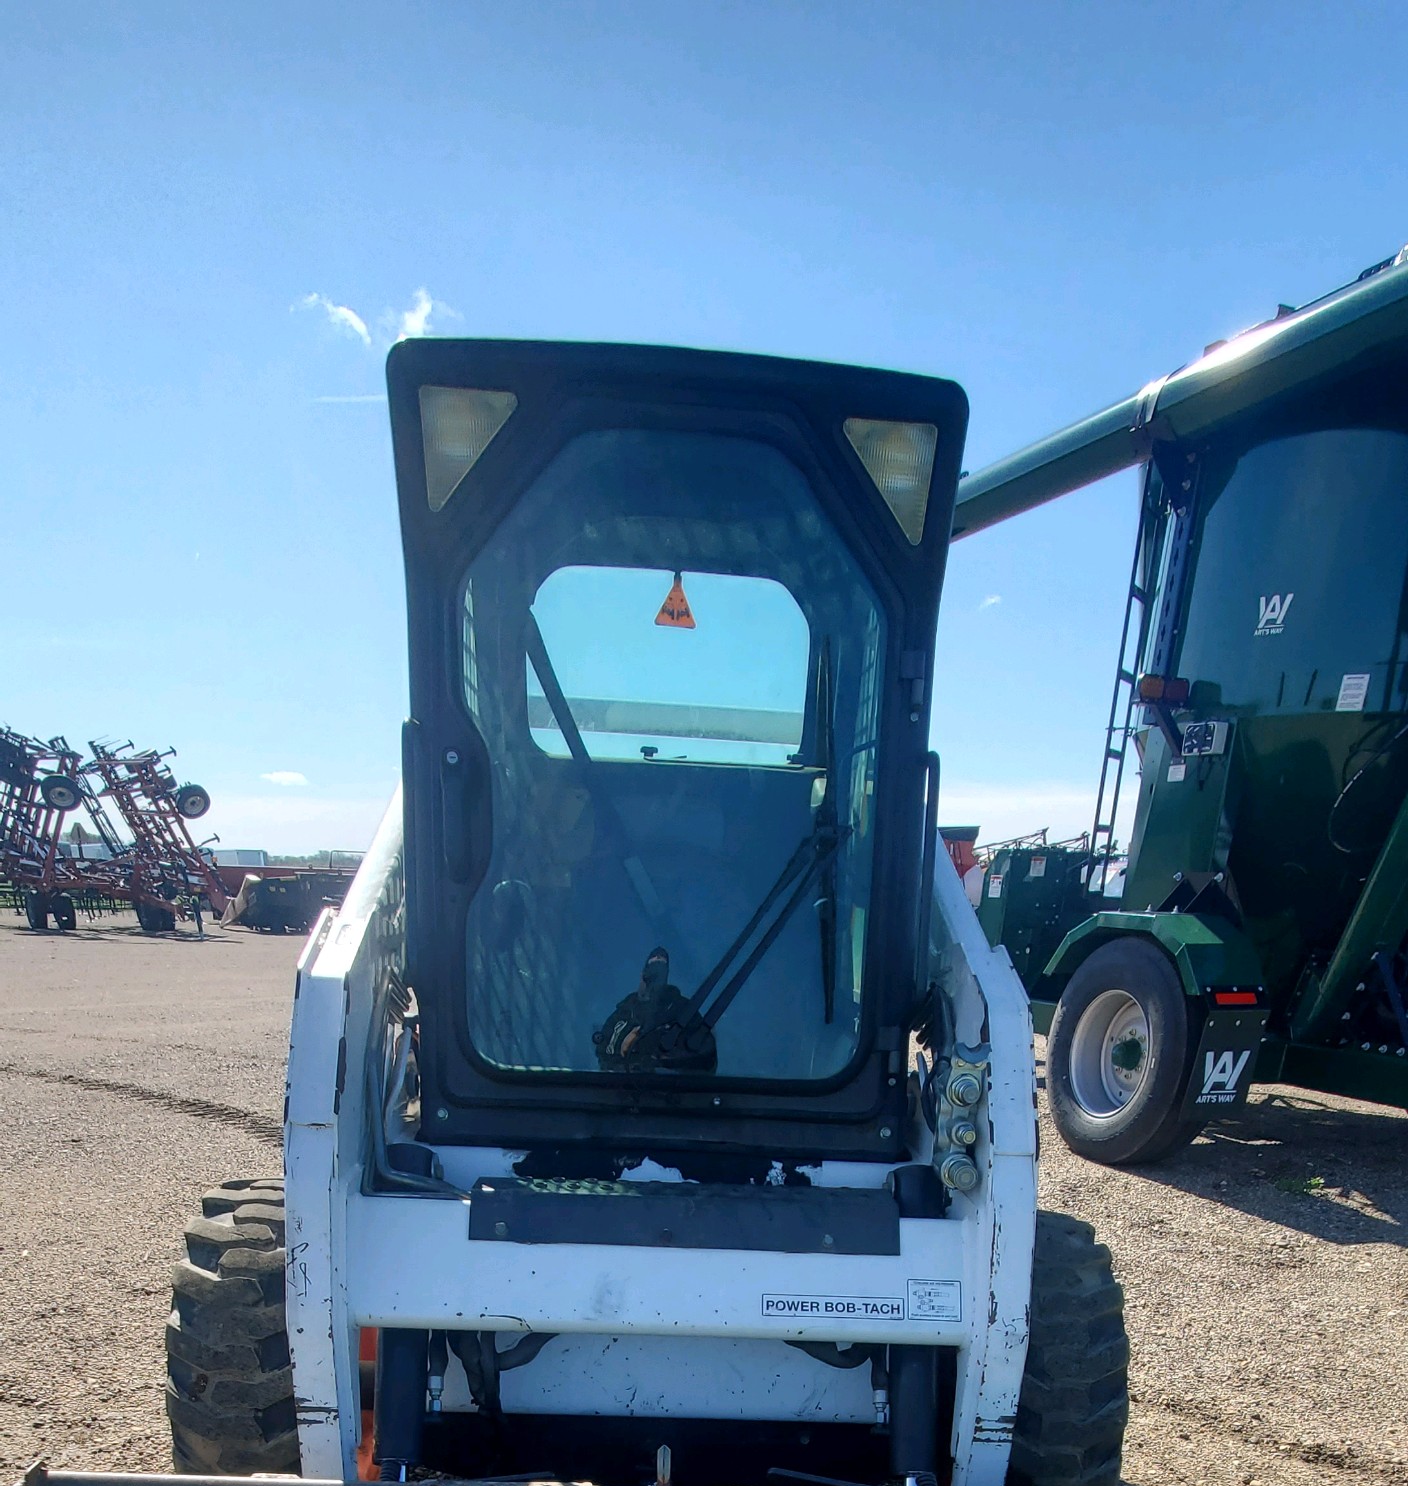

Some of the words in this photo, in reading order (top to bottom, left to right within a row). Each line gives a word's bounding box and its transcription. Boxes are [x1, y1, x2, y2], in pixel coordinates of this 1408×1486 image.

[1270, 627, 1284, 635] WAY
[1195, 1095, 1217, 1104] ART'S
[1218, 1094, 1236, 1103] WAY
[765, 1300, 820, 1312] POWER
[824, 1301, 901, 1315] BOB-TACH
